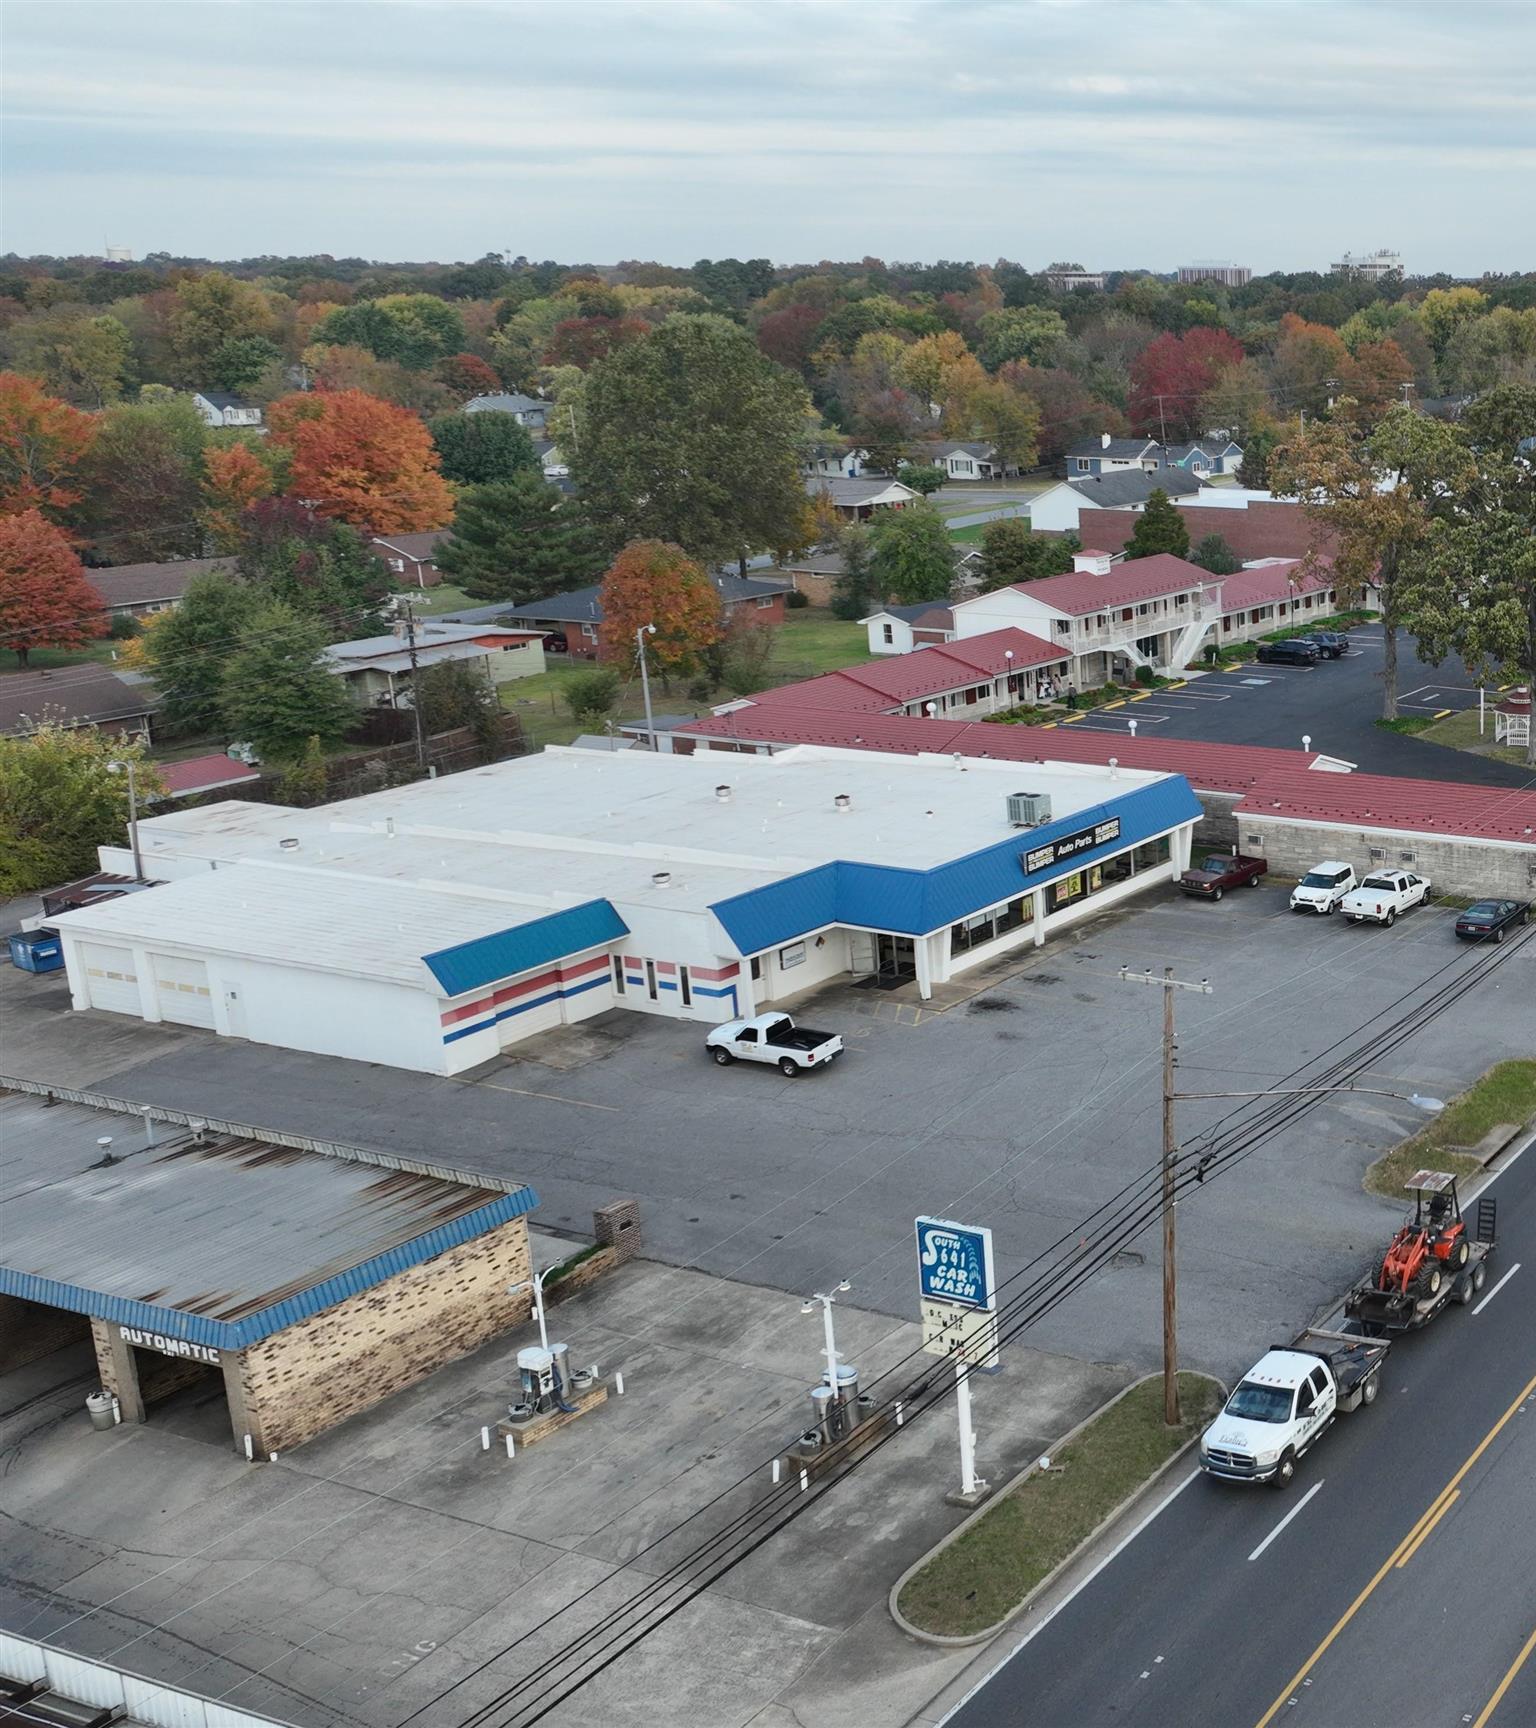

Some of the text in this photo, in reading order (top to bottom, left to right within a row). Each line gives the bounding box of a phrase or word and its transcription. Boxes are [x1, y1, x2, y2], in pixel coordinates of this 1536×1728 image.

[1095, 819, 1119, 835] BUMPER
[1057, 835, 1093, 856] Auto Parts
[1095, 829, 1120, 845] BUMPER
[1028, 845, 1054, 862] BUMPER
[1028, 855, 1055, 872] BUMPER
[922, 1230, 961, 1266] SOUTH
[940, 1248, 967, 1268] 641
[937, 1265, 968, 1284] CAR
[929, 1276, 976, 1297] WASH
[119, 1326, 220, 1363] AUTOMATIC
